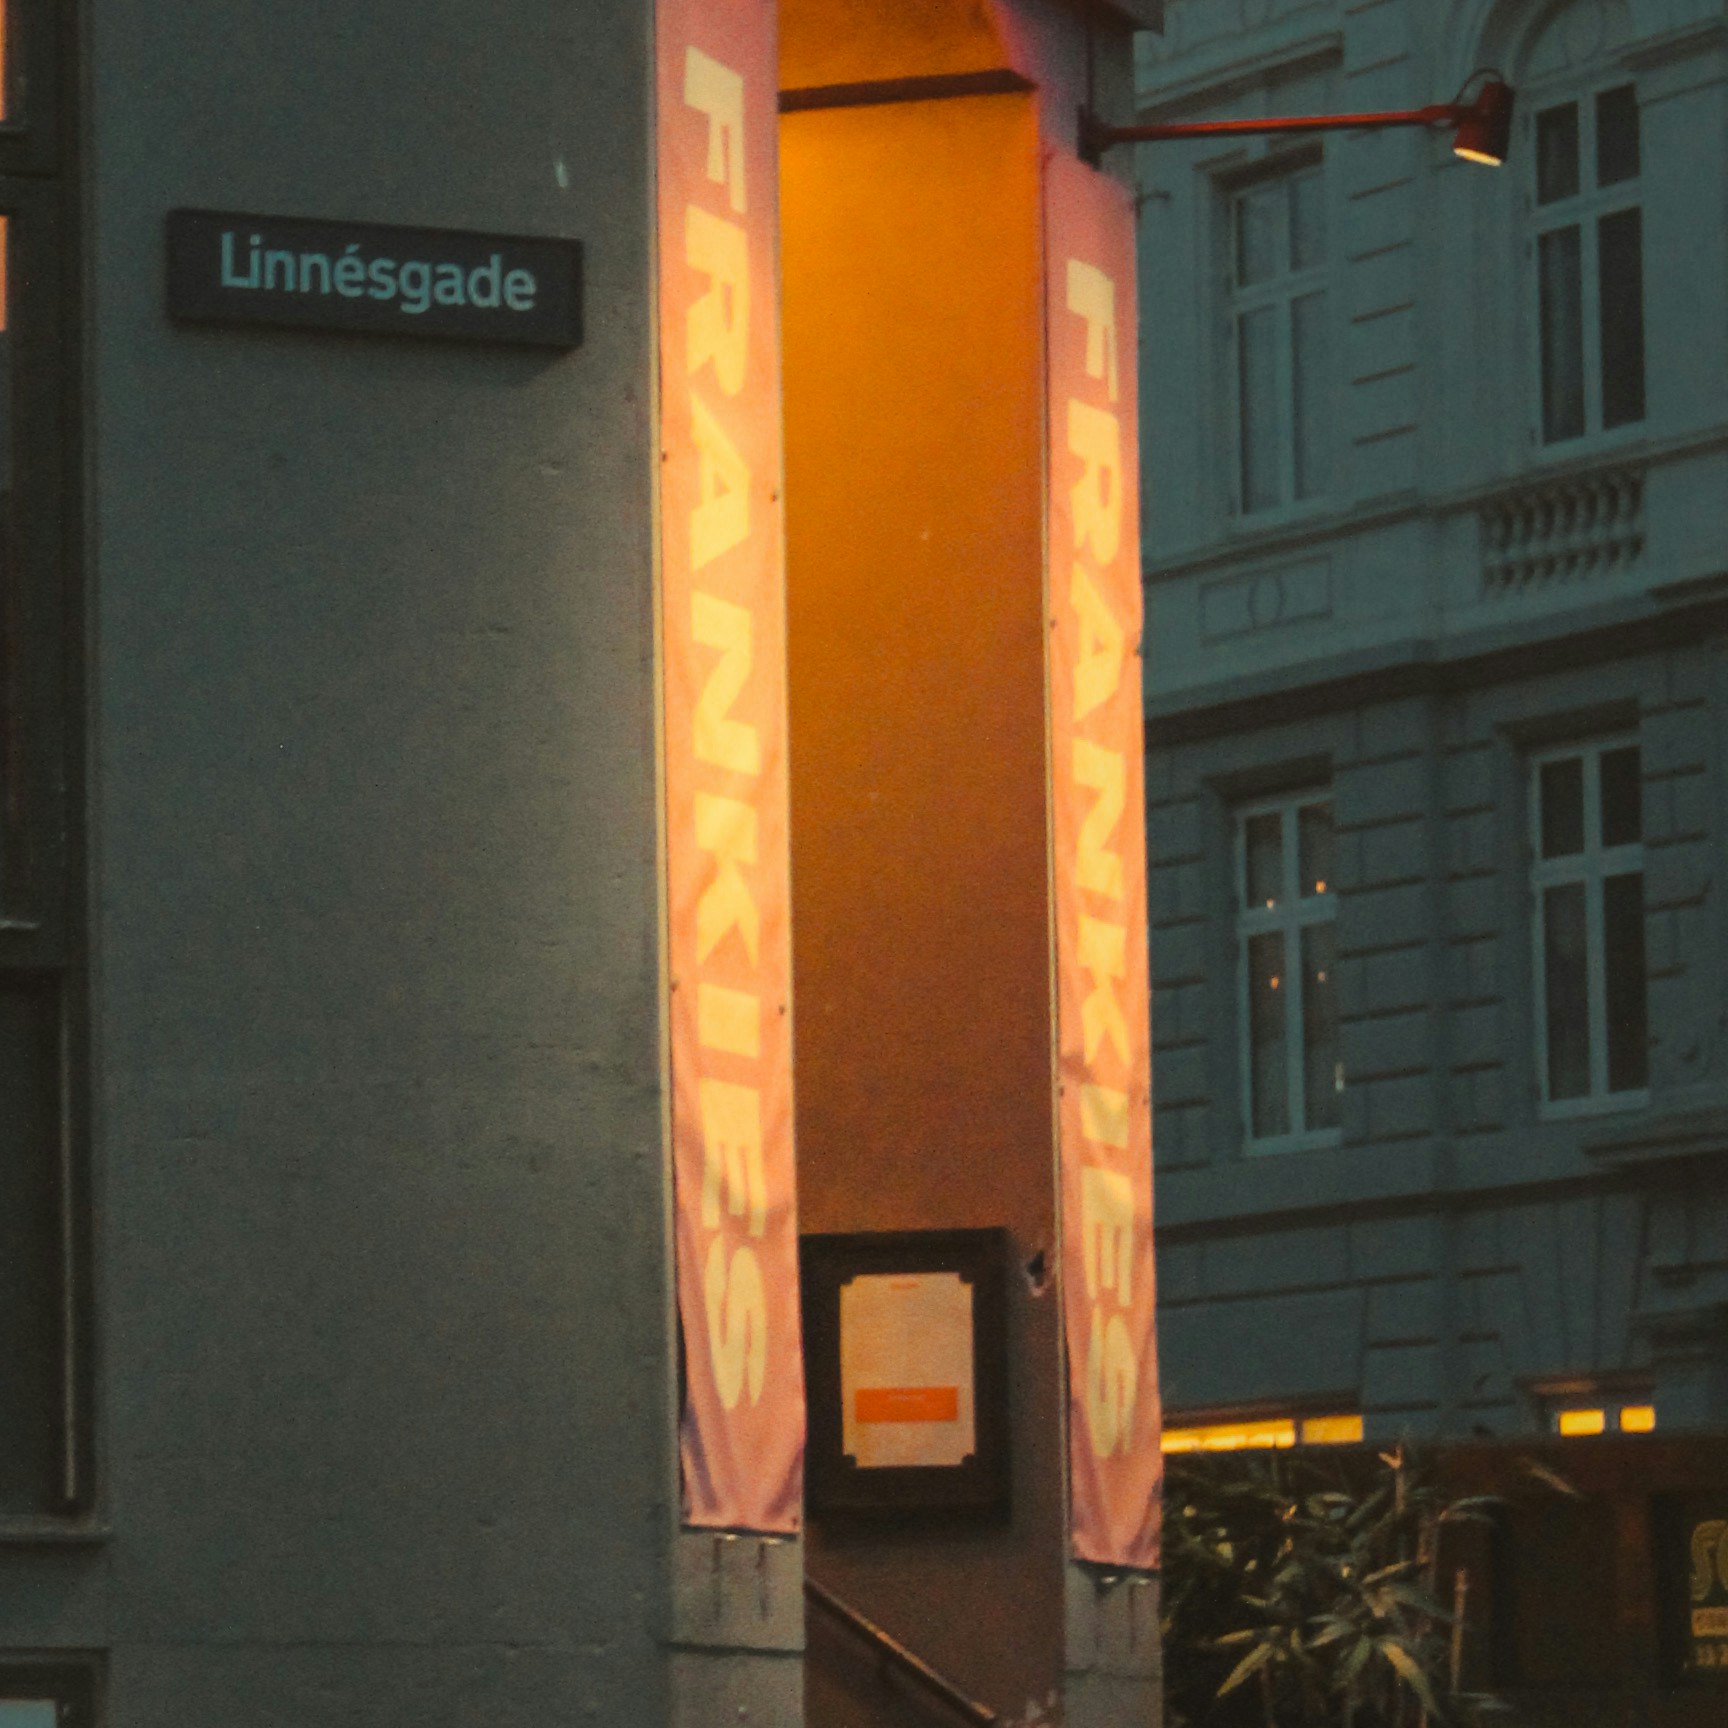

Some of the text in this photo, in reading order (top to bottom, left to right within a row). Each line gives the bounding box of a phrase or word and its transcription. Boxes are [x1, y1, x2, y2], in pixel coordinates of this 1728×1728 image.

[220, 230, 539, 315] Linnésgade
[683, 45, 769, 1410] FRANKIES
[1065, 257, 1138, 1460] FRANKIES
